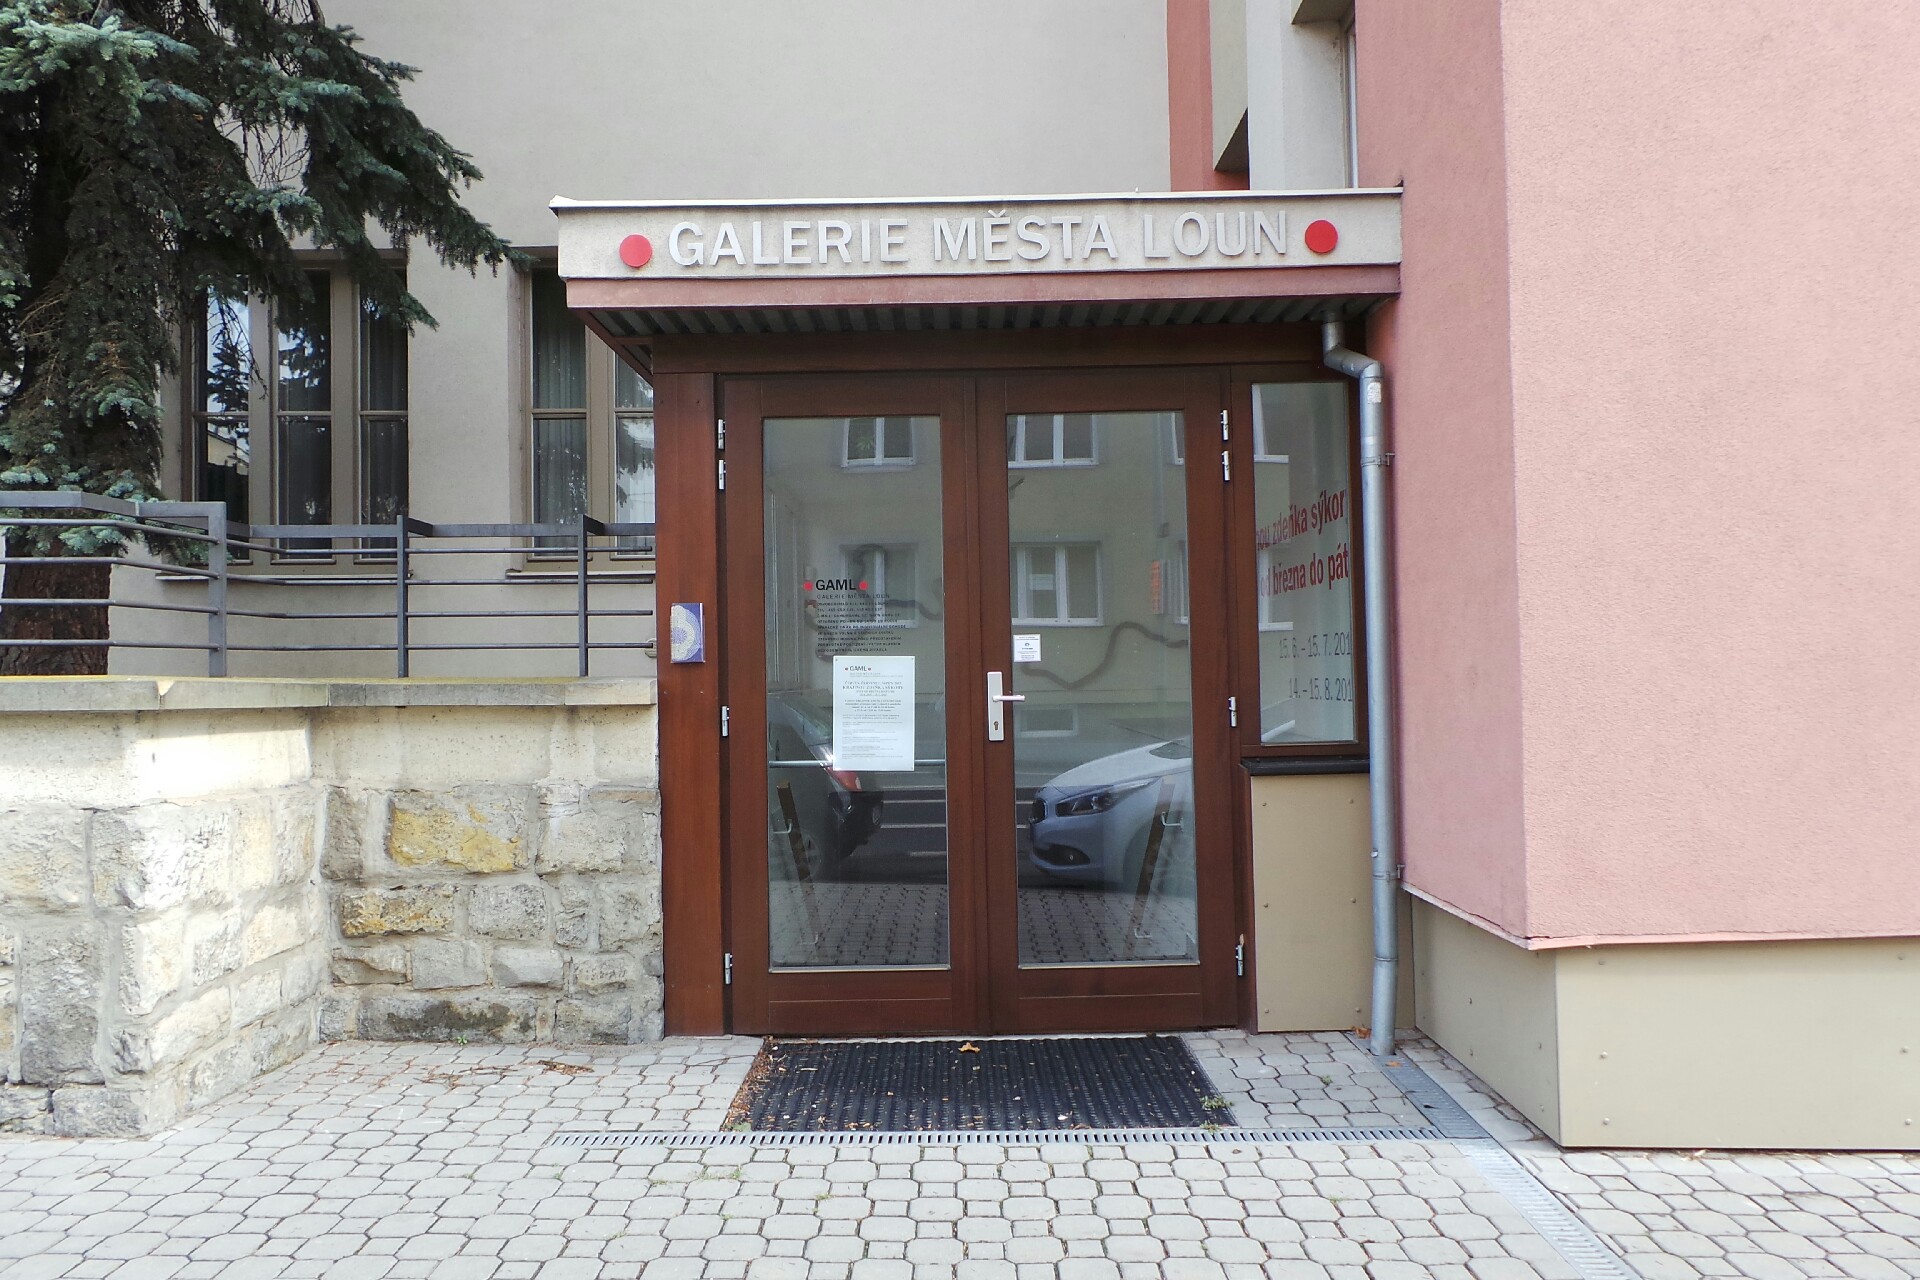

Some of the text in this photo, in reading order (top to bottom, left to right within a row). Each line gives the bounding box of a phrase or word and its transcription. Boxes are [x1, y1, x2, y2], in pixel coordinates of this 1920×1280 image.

[667, 209, 1287, 267] GALERIE MĚSTA LOUN
[815, 579, 857, 591] GAML
[1309, 552, 1324, 586] do
